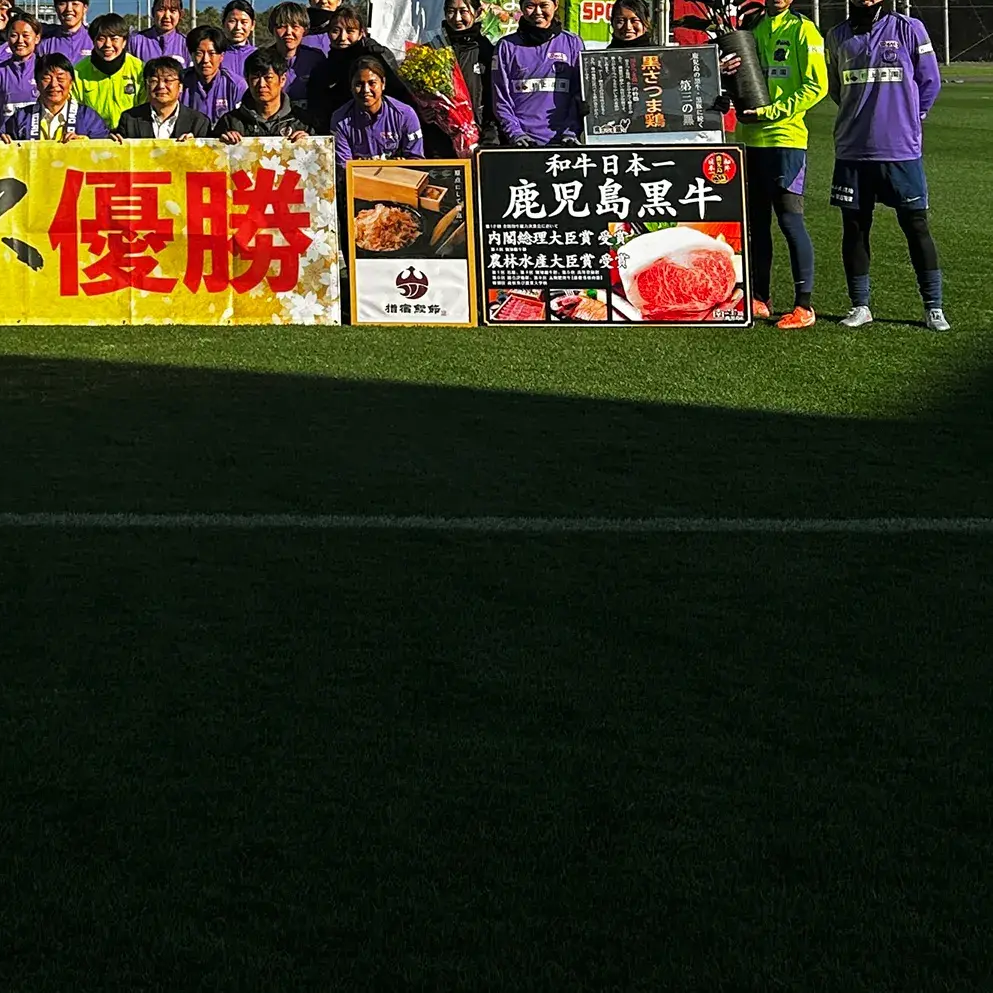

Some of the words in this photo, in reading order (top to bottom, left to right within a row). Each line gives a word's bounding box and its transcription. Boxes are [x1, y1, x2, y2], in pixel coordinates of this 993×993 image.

[545, 153, 676, 178] 和牛日本一
[501, 177, 723, 219] 鹿児島黒牛
[488, 230, 595, 246] 内閣総理大臣賞
[487, 252, 596, 269] 農林水産大臣賞
